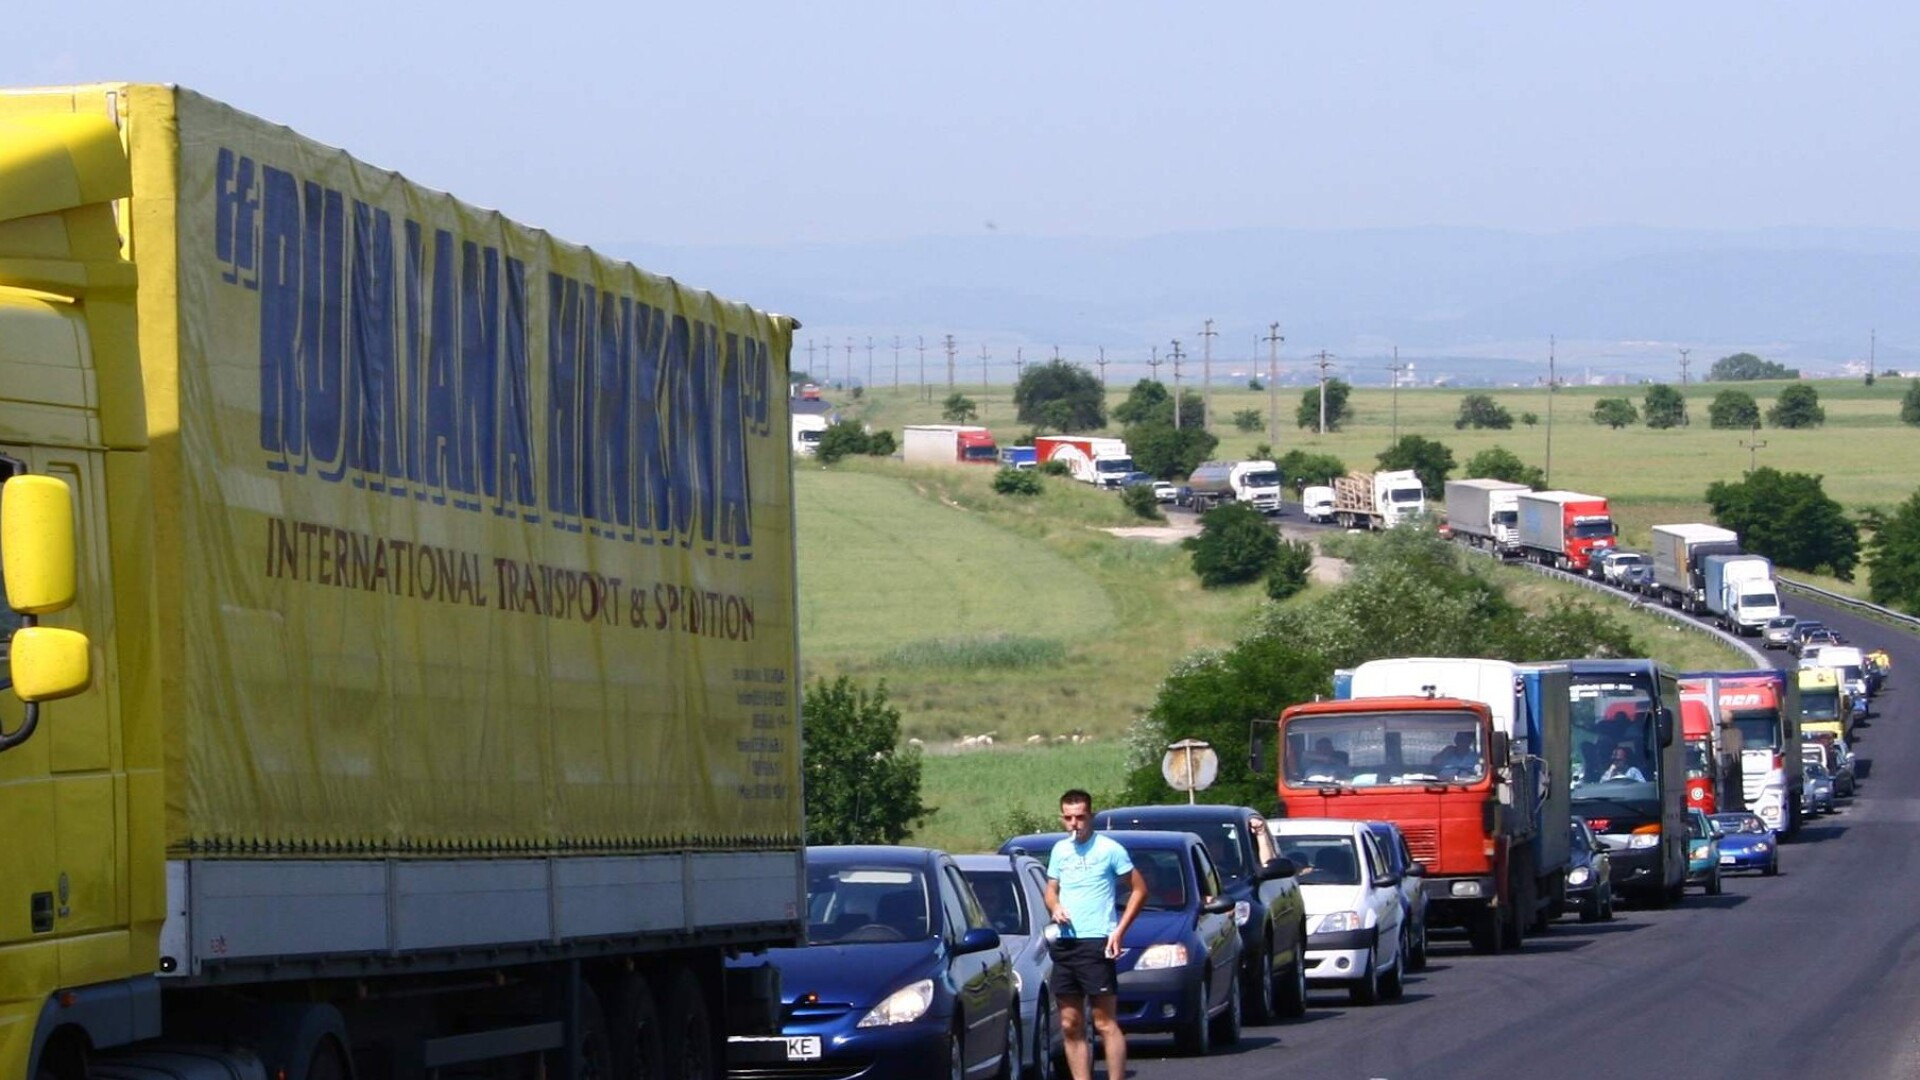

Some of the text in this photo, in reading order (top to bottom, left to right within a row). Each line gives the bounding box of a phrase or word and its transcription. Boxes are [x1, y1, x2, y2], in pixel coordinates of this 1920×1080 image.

[266, 518, 486, 607] INTERNATIONAL
[493, 557, 621, 626] TRANSPORT
[630, 588, 648, 629] &
